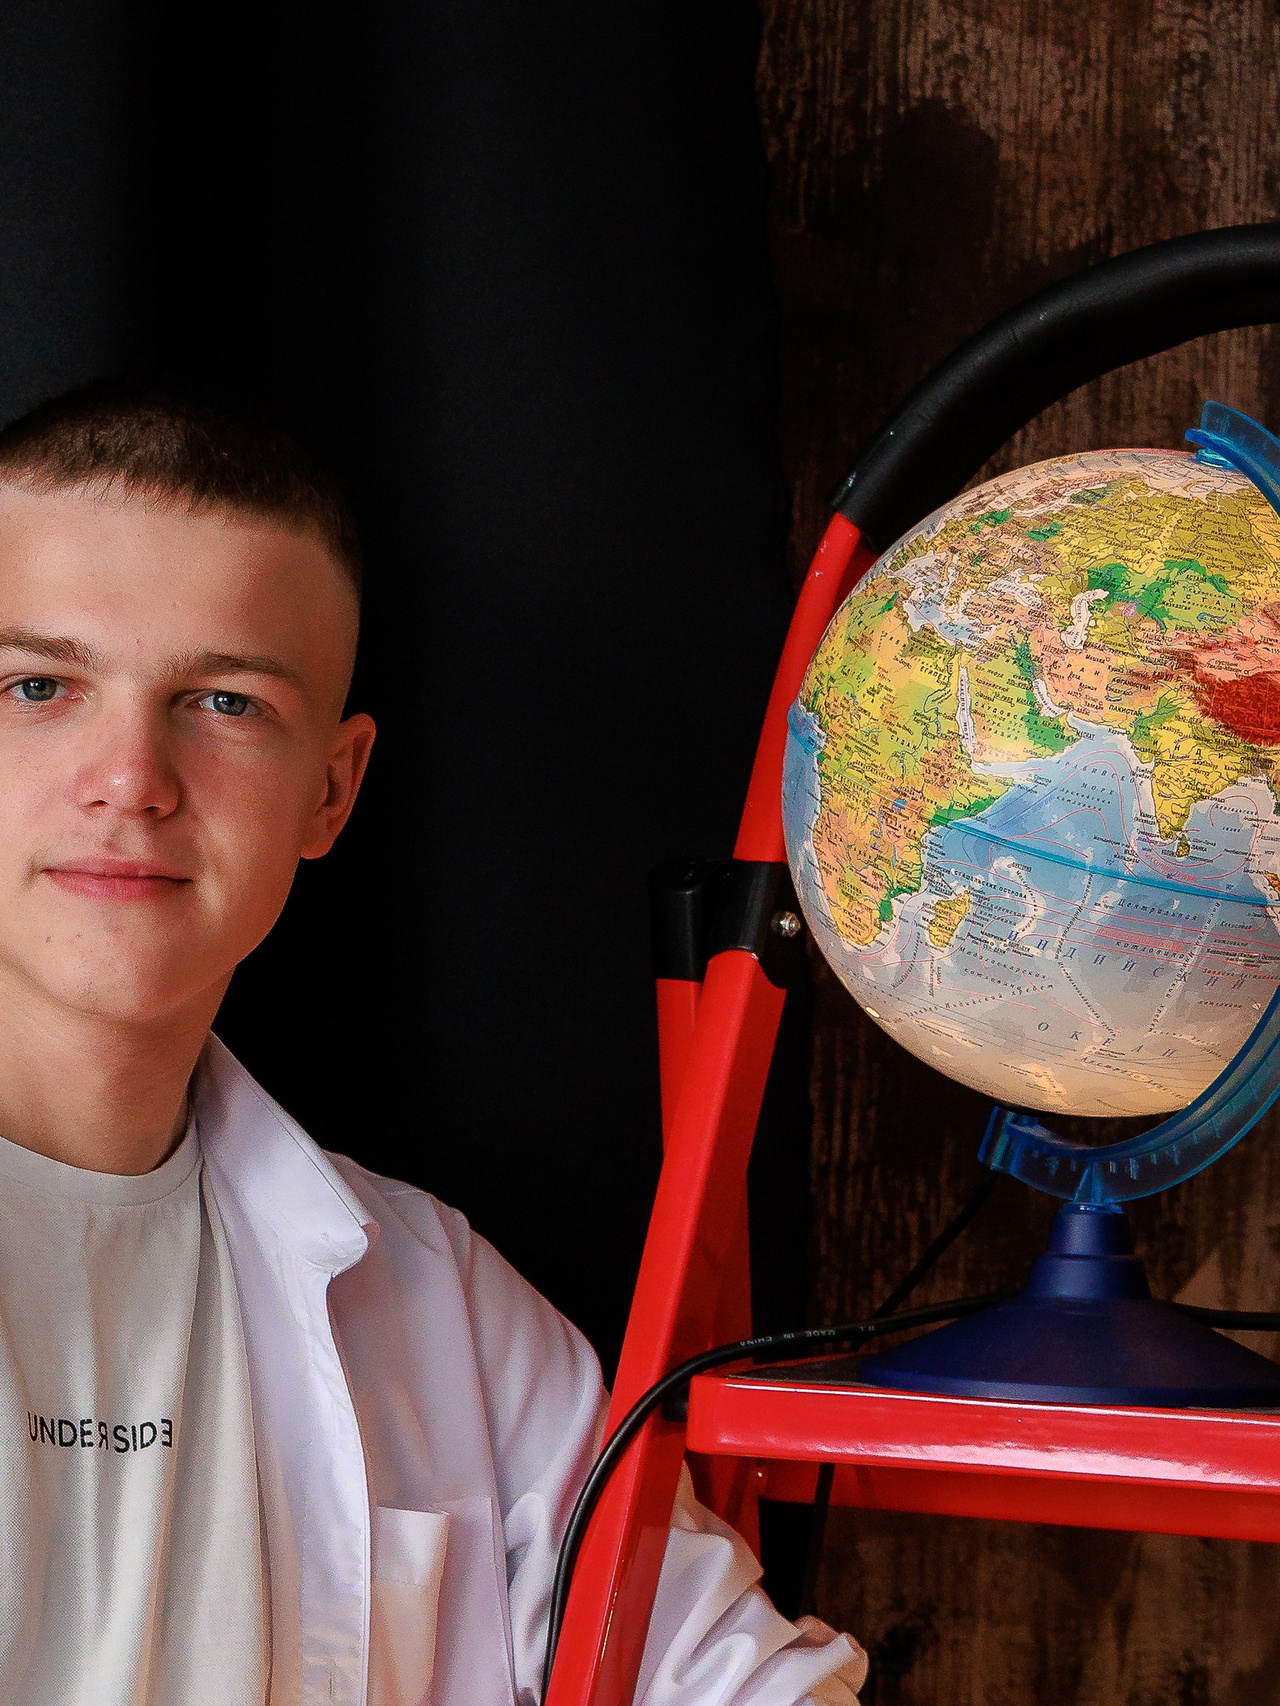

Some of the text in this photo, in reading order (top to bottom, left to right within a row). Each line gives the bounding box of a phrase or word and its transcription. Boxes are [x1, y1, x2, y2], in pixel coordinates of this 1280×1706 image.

[1108, 704, 1144, 717] ПАКИСТАН
[1037, 1021, 1178, 1057] ОКЕАН
[739, 1329, 836, 1347] MADE IN CHINA
